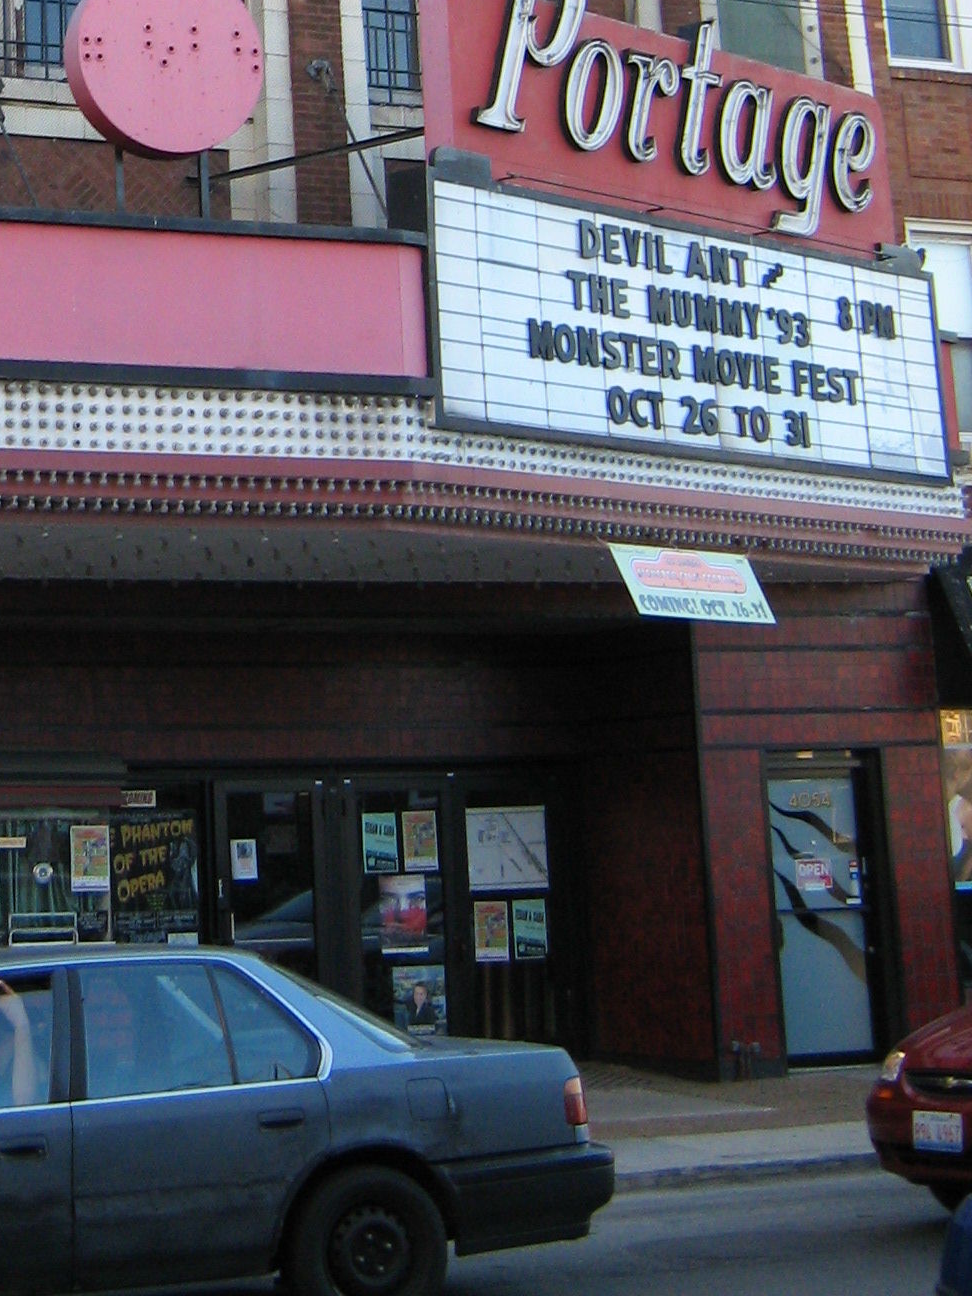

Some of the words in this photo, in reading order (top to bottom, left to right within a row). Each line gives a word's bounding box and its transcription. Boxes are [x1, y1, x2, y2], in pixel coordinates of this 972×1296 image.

[578, 219, 673, 274] DEVIL
[686, 241, 749, 287] ANT
[566, 270, 630, 319] THE
[647, 284, 760, 340] MUMMY
[837, 297, 853, 331] 8
[862, 299, 896, 340] PM
[528, 318, 681, 380] MONSTER
[693, 345, 782, 395] MOVIE
[792, 360, 859, 405] FEST
[608, 386, 663, 430] OCT
[680, 395, 719, 436] 26
[734, 405, 770, 443] TO
[784, 410, 811, 448] 31
[639, 594, 700, 615] COMING!
[120, 818, 194, 848] PHANTOM
[113, 852, 134, 874] OF
[138, 845, 167, 867] THE
[798, 863, 829, 876] OPEN
[117, 869, 166, 902] OPERA
